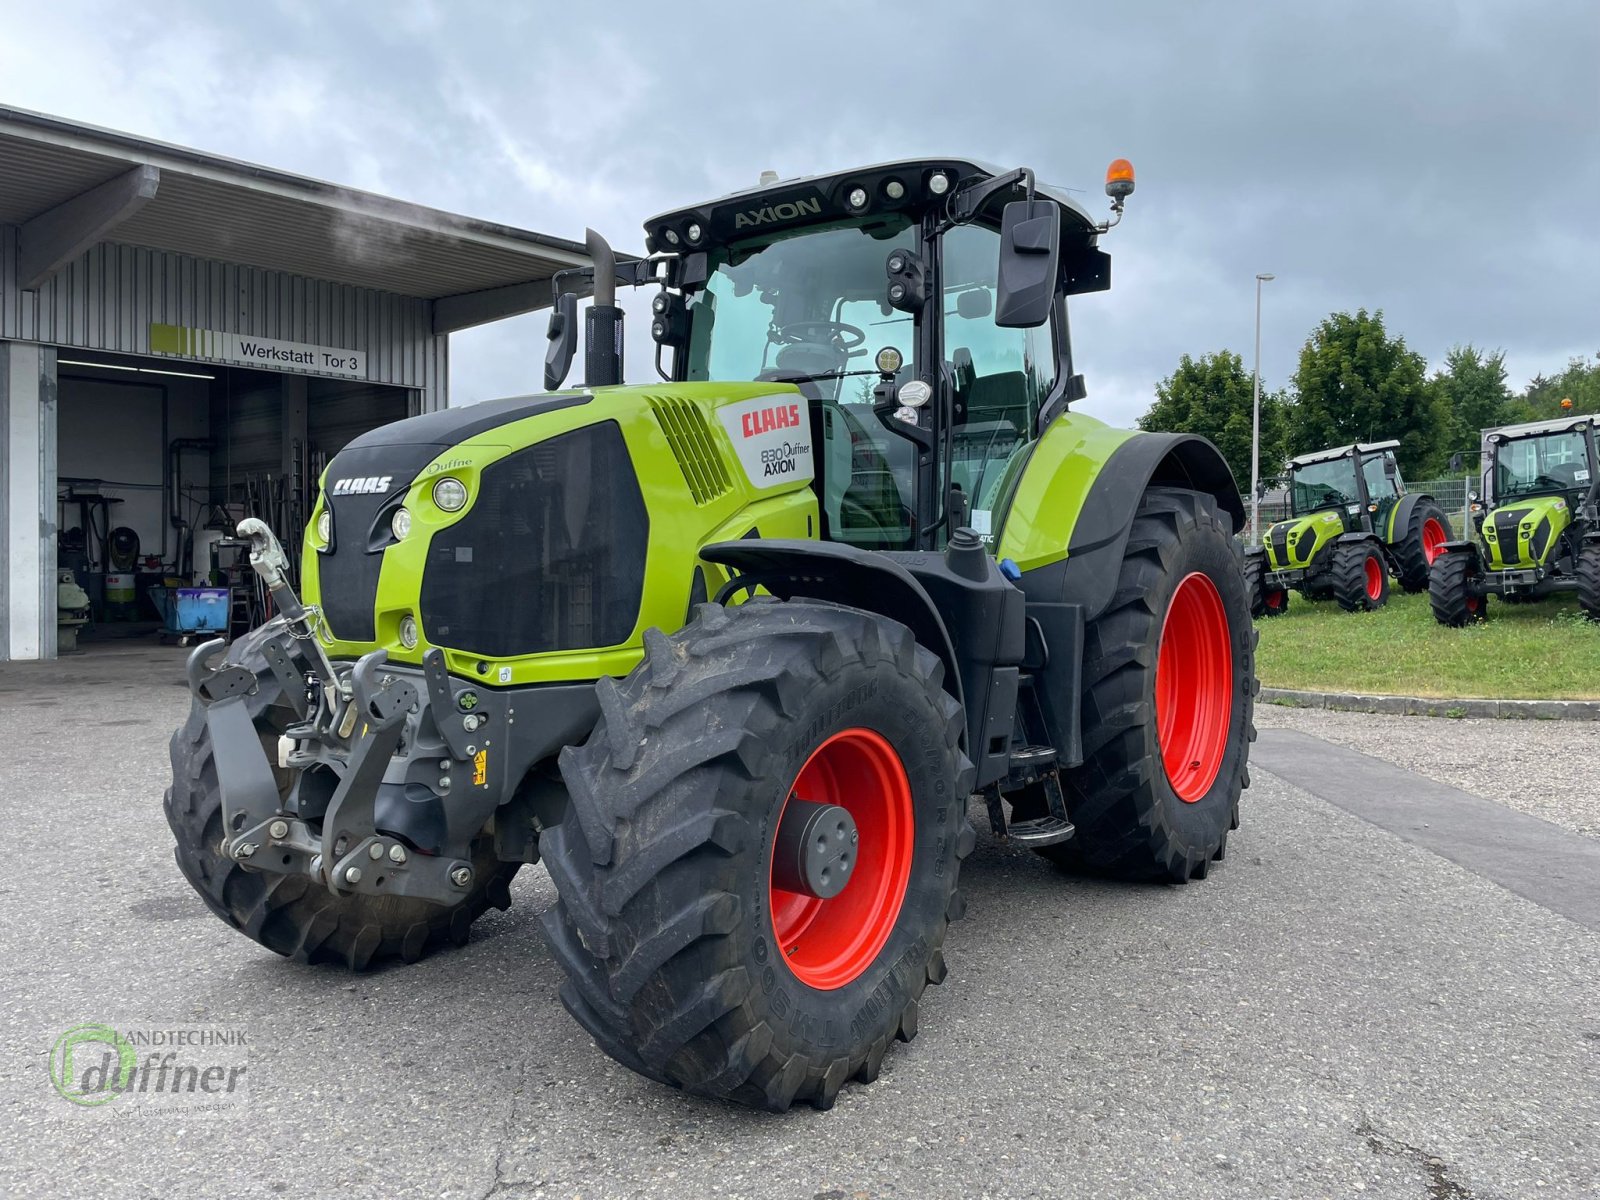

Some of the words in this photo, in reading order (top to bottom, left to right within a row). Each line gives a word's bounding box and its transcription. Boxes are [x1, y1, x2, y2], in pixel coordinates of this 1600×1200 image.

[735, 197, 821, 229] AXION
[240, 341, 314, 364] Werkstatt
[322, 353, 345, 369] Tor
[349, 357, 358, 370] 3
[742, 404, 800, 438] CLAAS
[761, 447, 783, 464] 830
[764, 458, 796, 477] AXION
[335, 475, 393, 496] CLAAS
[979, 535, 995, 544] ATIC
